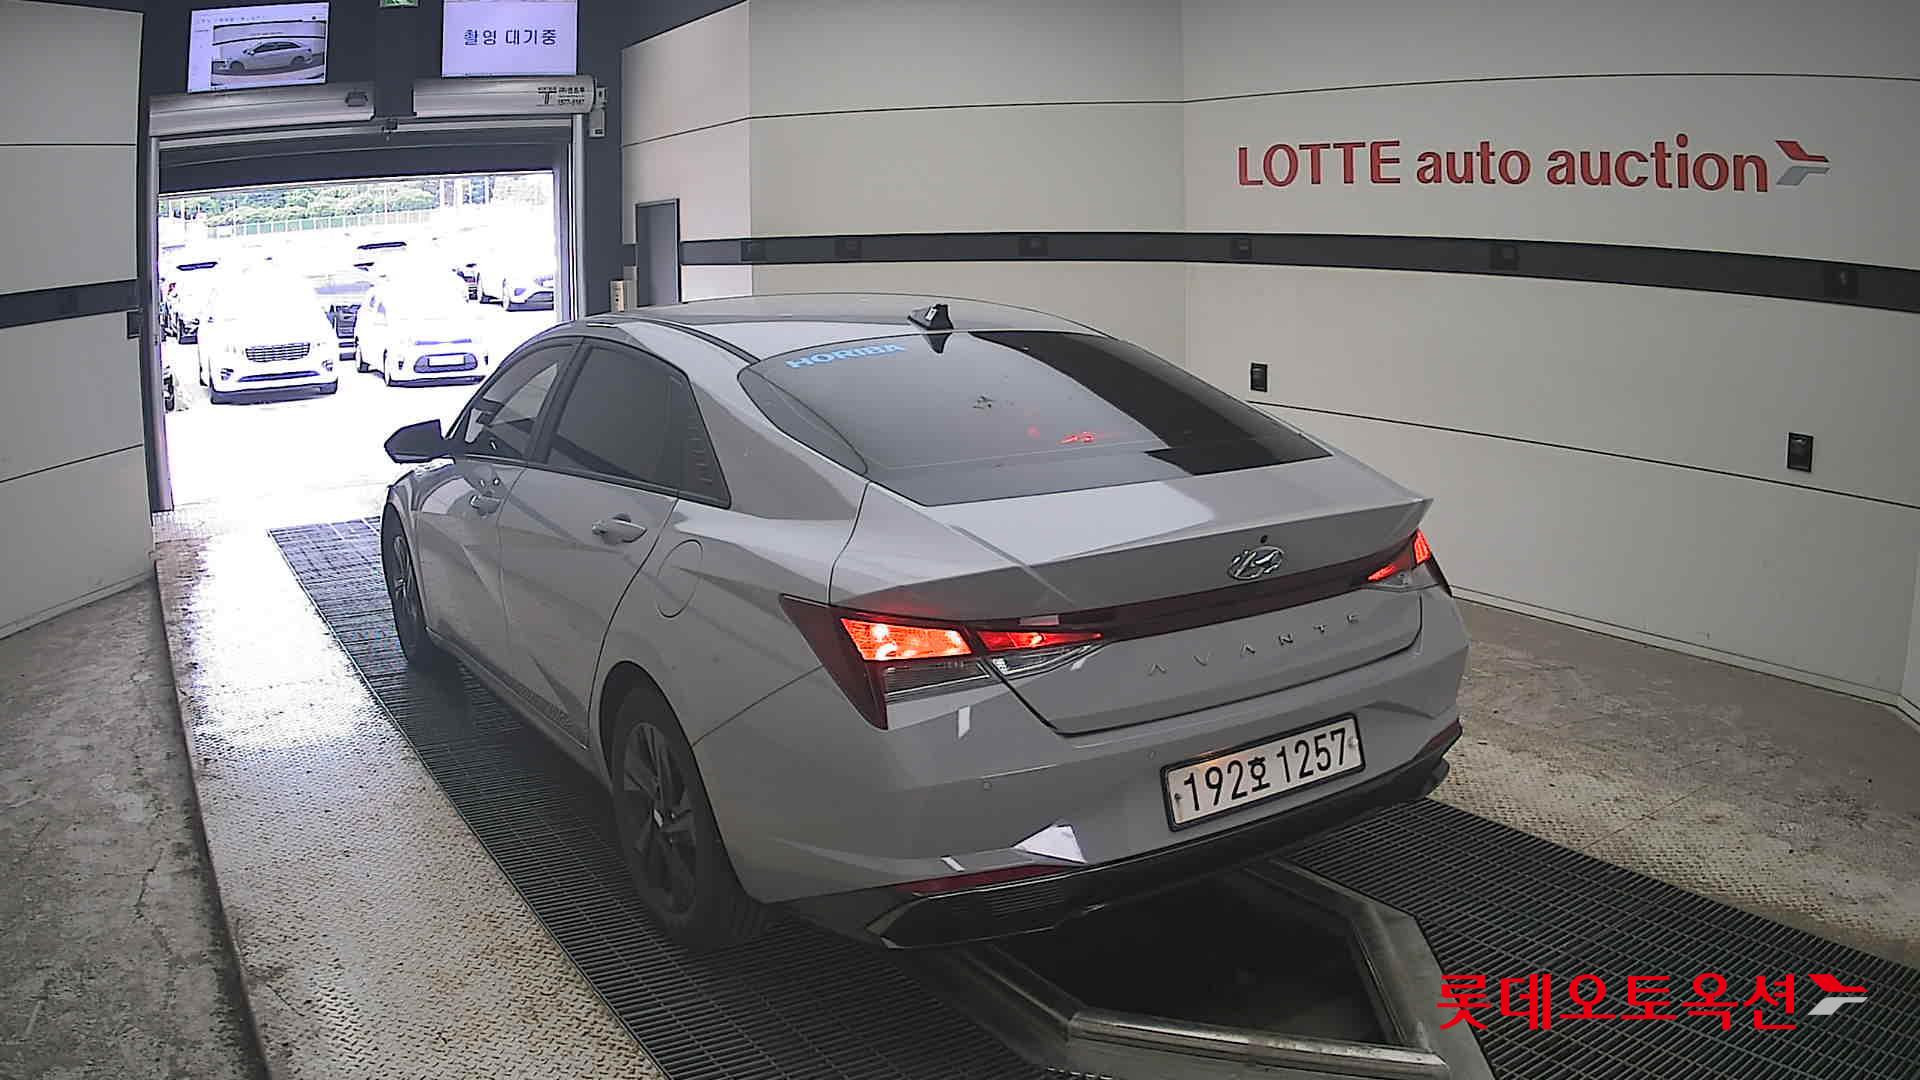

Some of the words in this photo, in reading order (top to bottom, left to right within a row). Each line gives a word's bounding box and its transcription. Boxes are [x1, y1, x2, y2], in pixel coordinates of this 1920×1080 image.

[505, 29, 557, 46] 대기중
[1238, 140, 1401, 188] LOTTE
[1416, 141, 1531, 186] auto
[1546, 134, 1770, 192] auction
[784, 344, 905, 368] HORIBA
[1147, 611, 1360, 677] AVANTE
[1183, 756, 1271, 811] 192호
[1276, 728, 1347, 784] 1257
